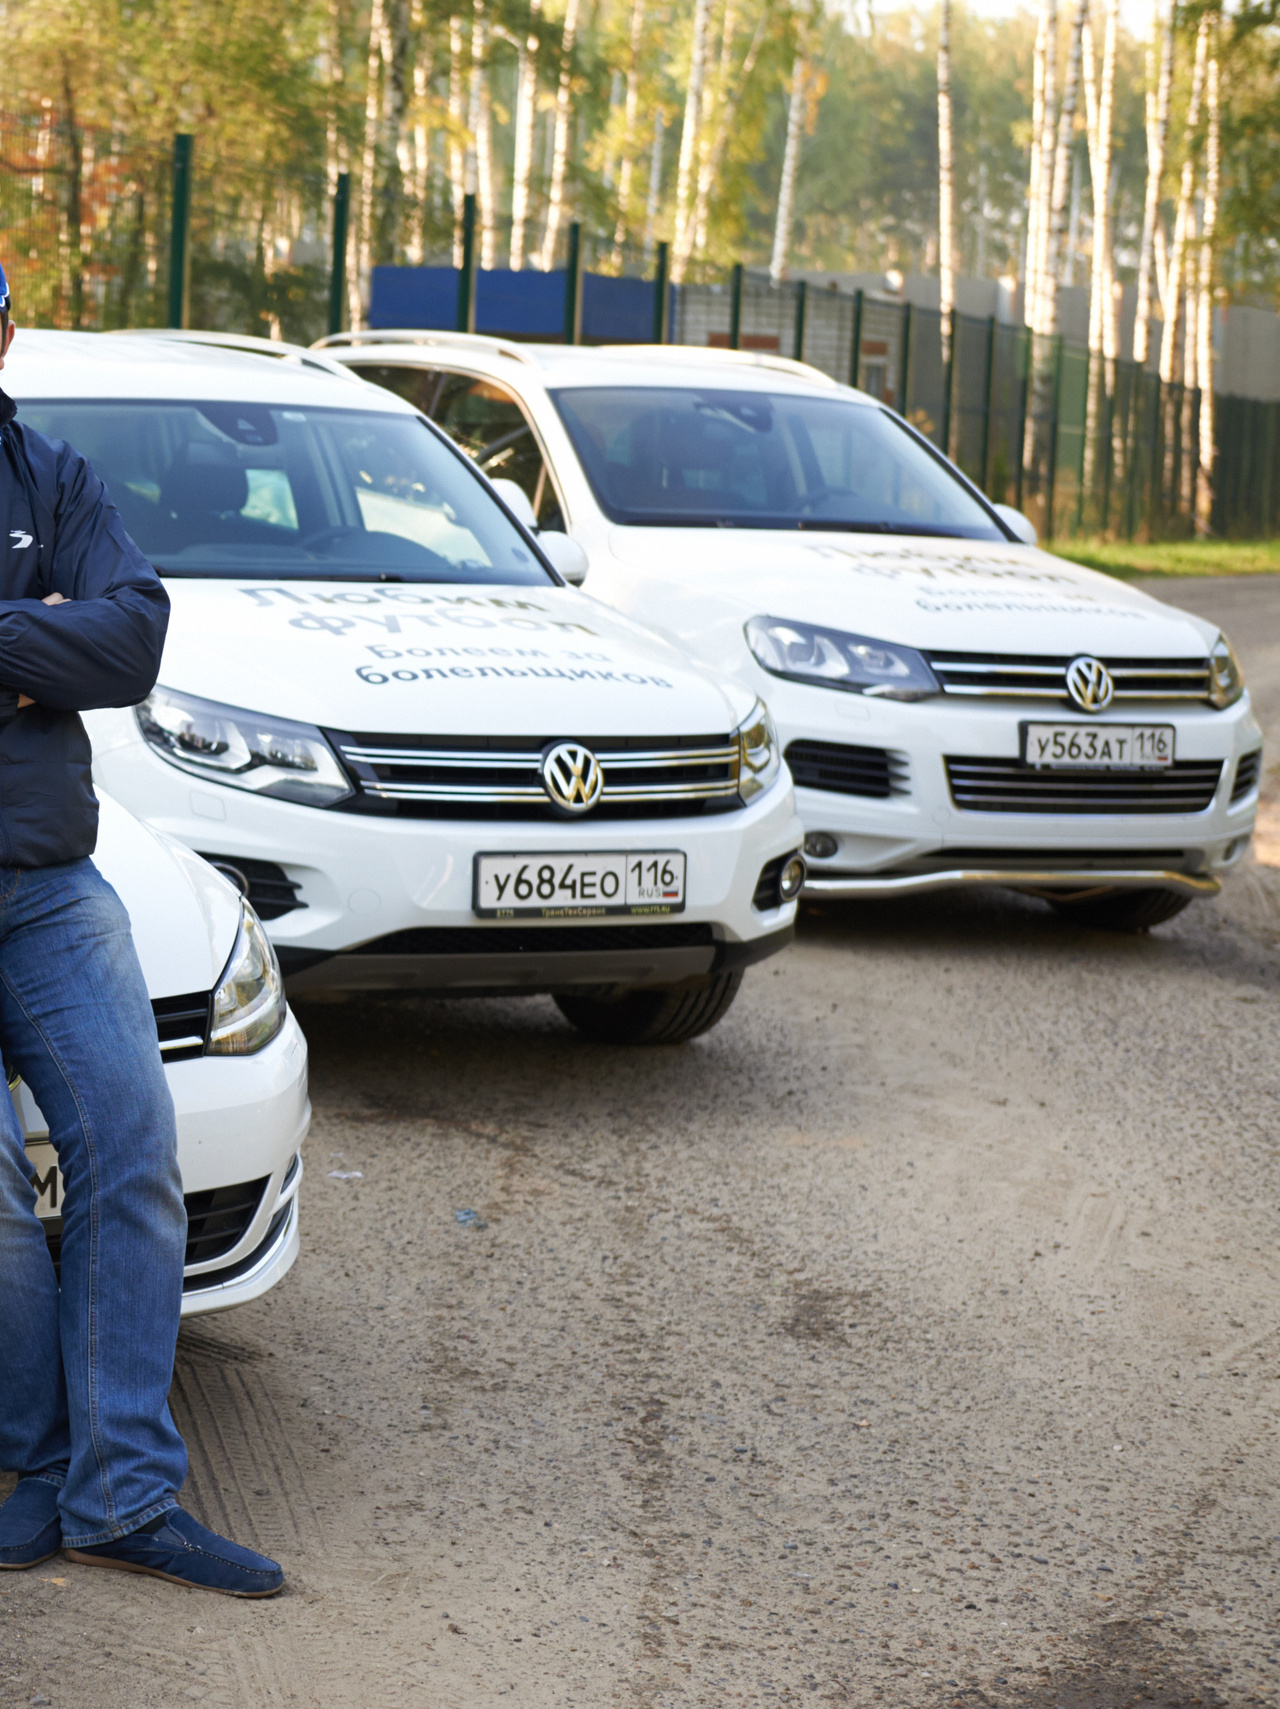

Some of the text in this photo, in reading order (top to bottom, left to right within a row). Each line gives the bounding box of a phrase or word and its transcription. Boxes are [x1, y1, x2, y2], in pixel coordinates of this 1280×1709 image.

[236, 587, 551, 613] Любим
[287, 606, 601, 636] футбол
[365, 644, 550, 659] Болеем
[355, 665, 674, 688] болельщиков
[1135, 731, 1168, 753] 116
[493, 859, 675, 901] У684ЕО 116
